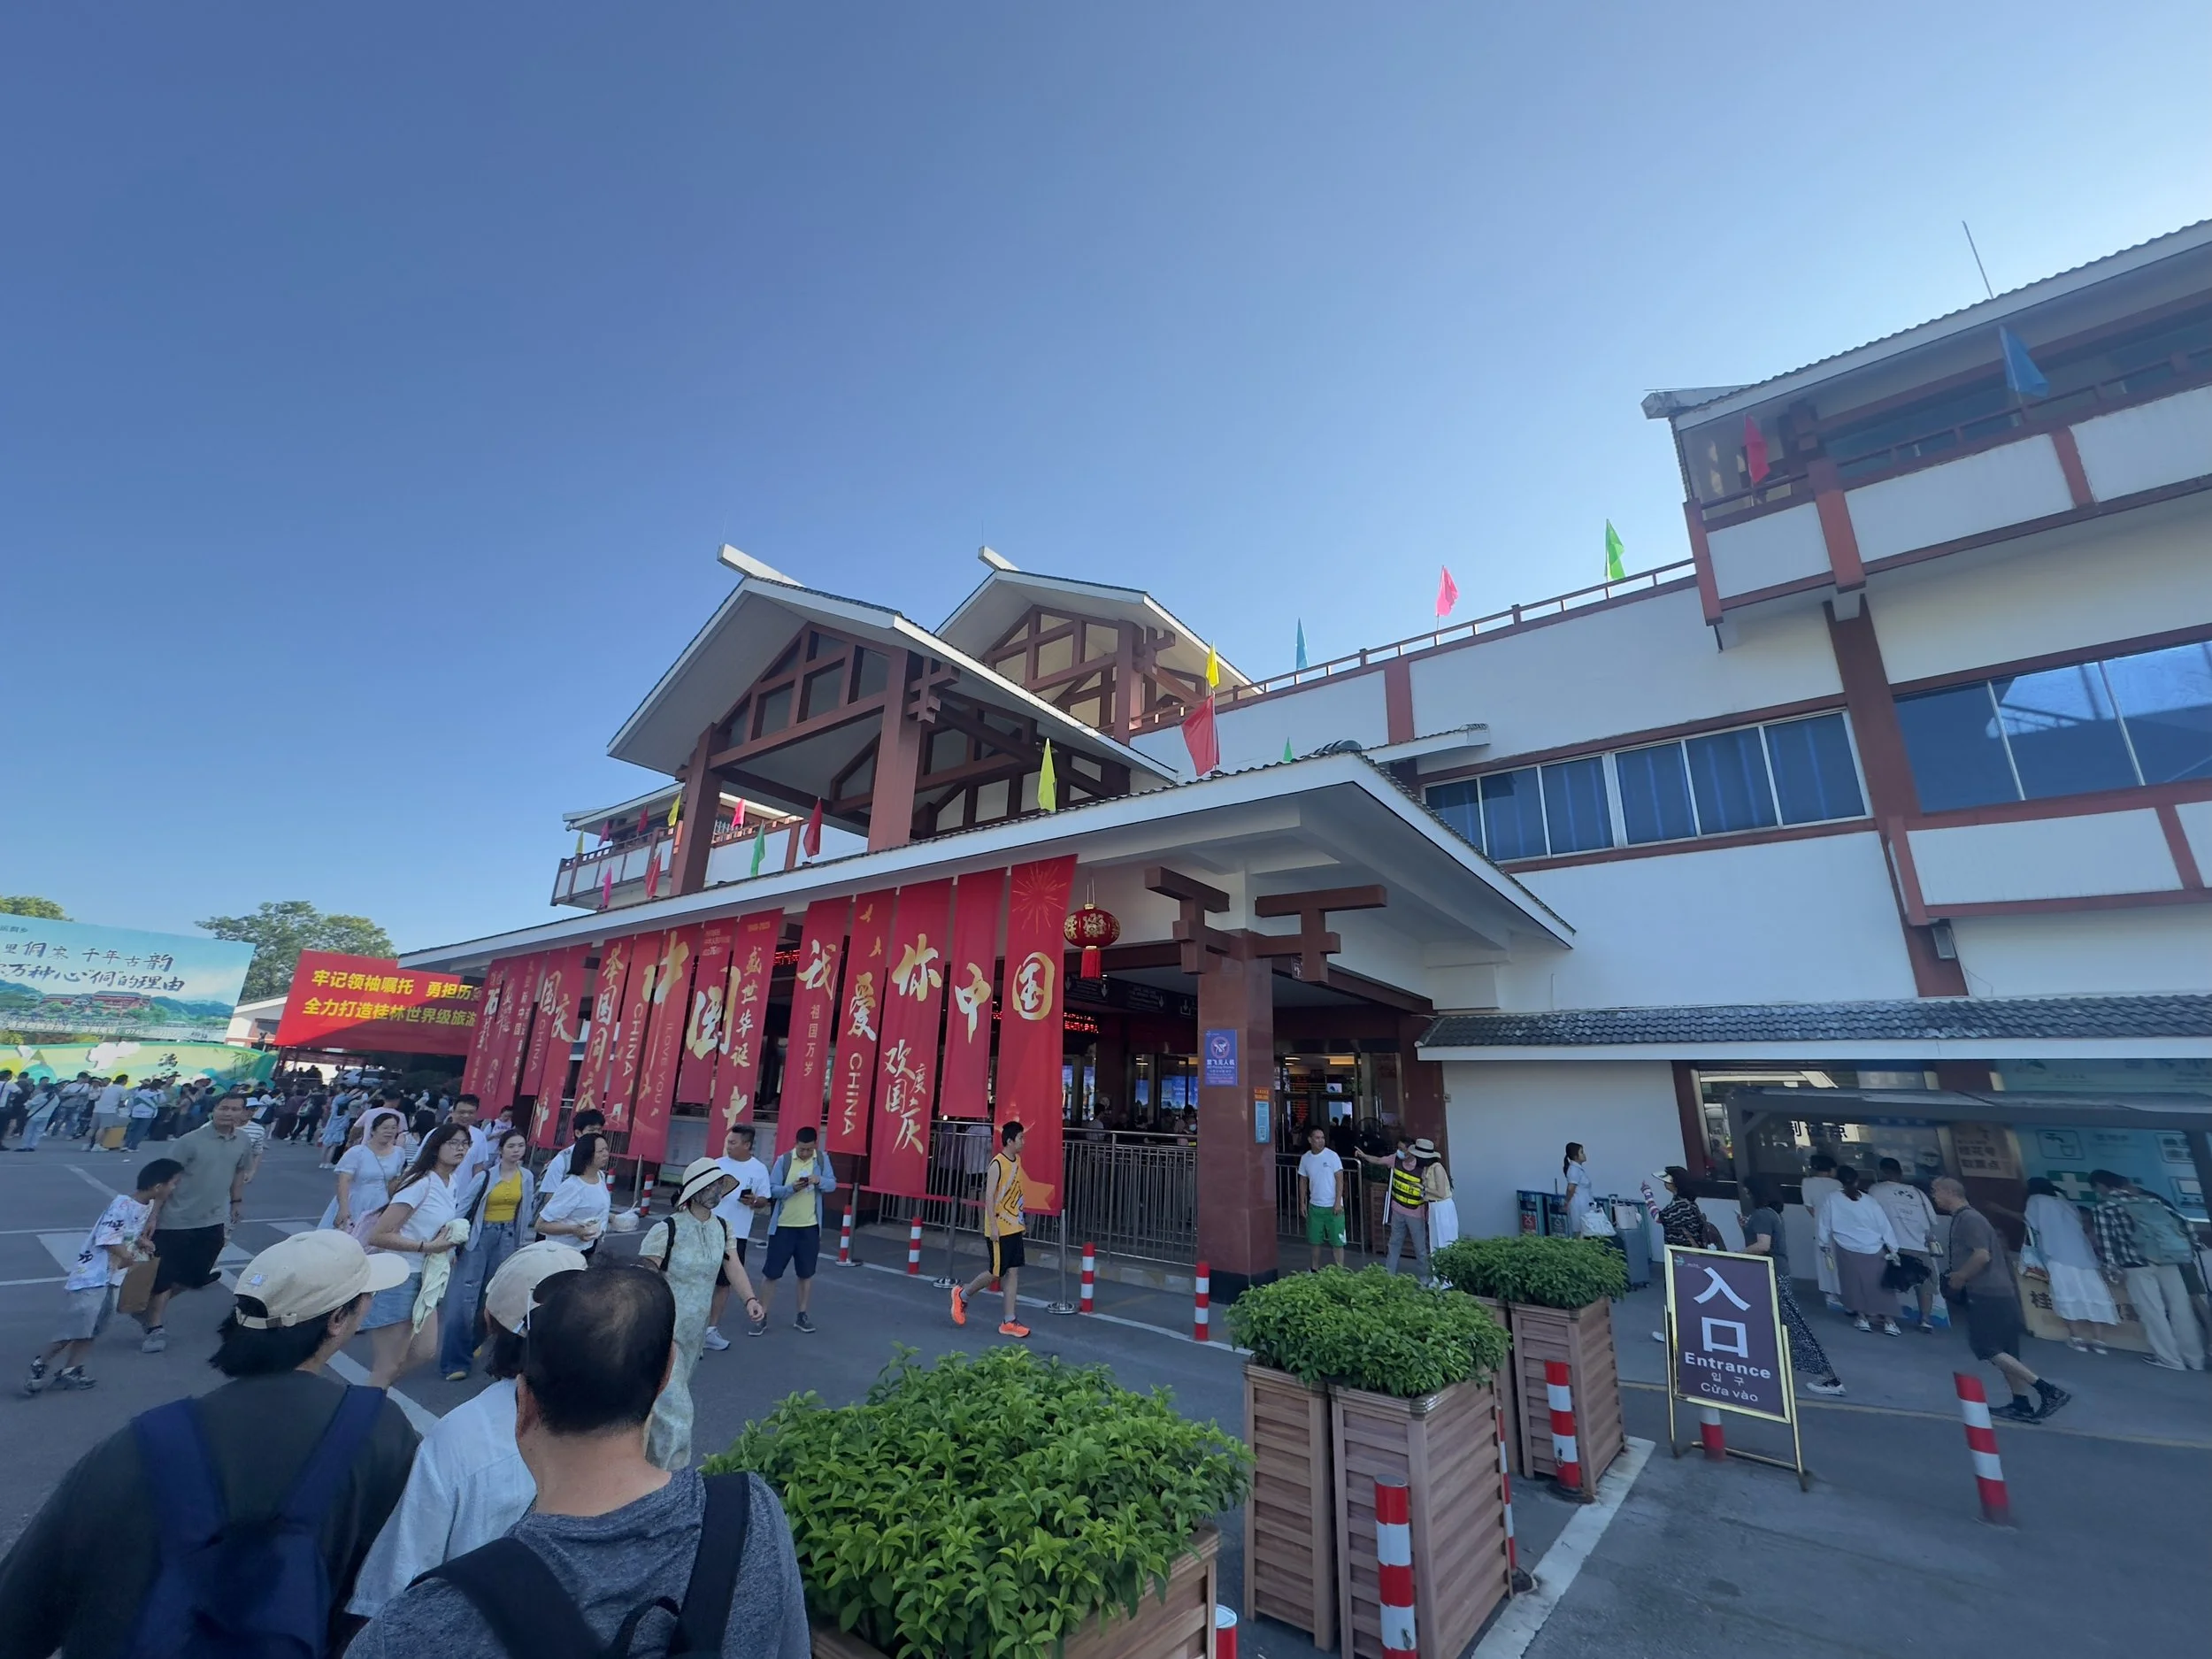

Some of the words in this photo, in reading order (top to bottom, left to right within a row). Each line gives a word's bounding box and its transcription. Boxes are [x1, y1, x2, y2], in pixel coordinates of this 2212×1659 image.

[311, 969, 415, 995] 牢记领袖嘱托
[730, 946, 763, 1068] 盛世华诞
[797, 939, 838, 1001] 我
[849, 972, 877, 1041] 爱
[891, 933, 942, 1002] 你
[954, 962, 992, 1045] 中
[1012, 951, 1056, 1021] 国
[623, 1002, 643, 1077] CHINA
[803, 1003, 821, 1077] 祖国万岁
[841, 1052, 863, 1136] CHINA
[1693, 1266, 1751, 1359] 入口
[1684, 1351, 1771, 1379] Entrance
[1732, 1387, 1759, 1402] vào
